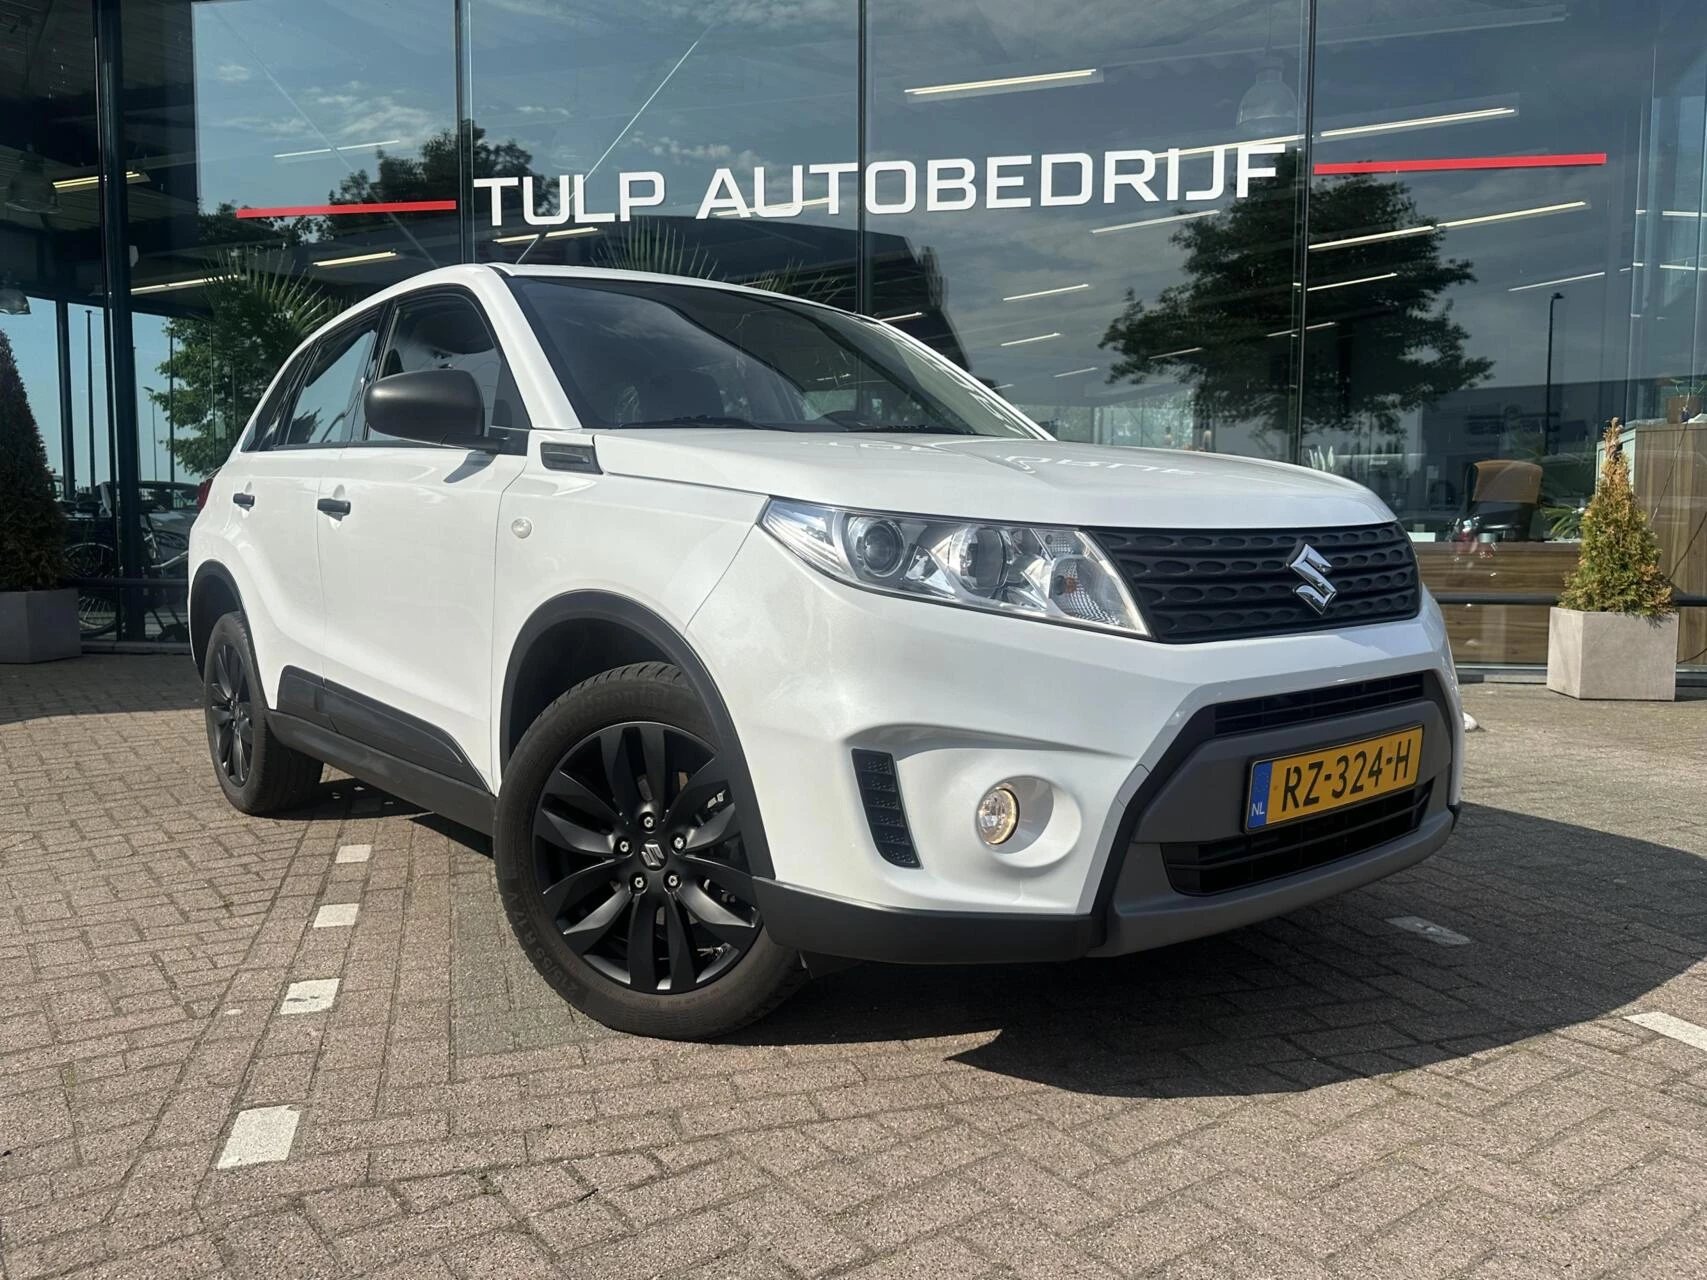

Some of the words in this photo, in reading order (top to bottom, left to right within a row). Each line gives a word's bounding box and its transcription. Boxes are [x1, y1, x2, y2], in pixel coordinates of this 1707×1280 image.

[473, 171, 665, 226] TULP
[696, 143, 1286, 220] AUTOBEDRIJF
[1251, 803, 1265, 816] NL
[1281, 738, 1411, 812] RZ-324-H
